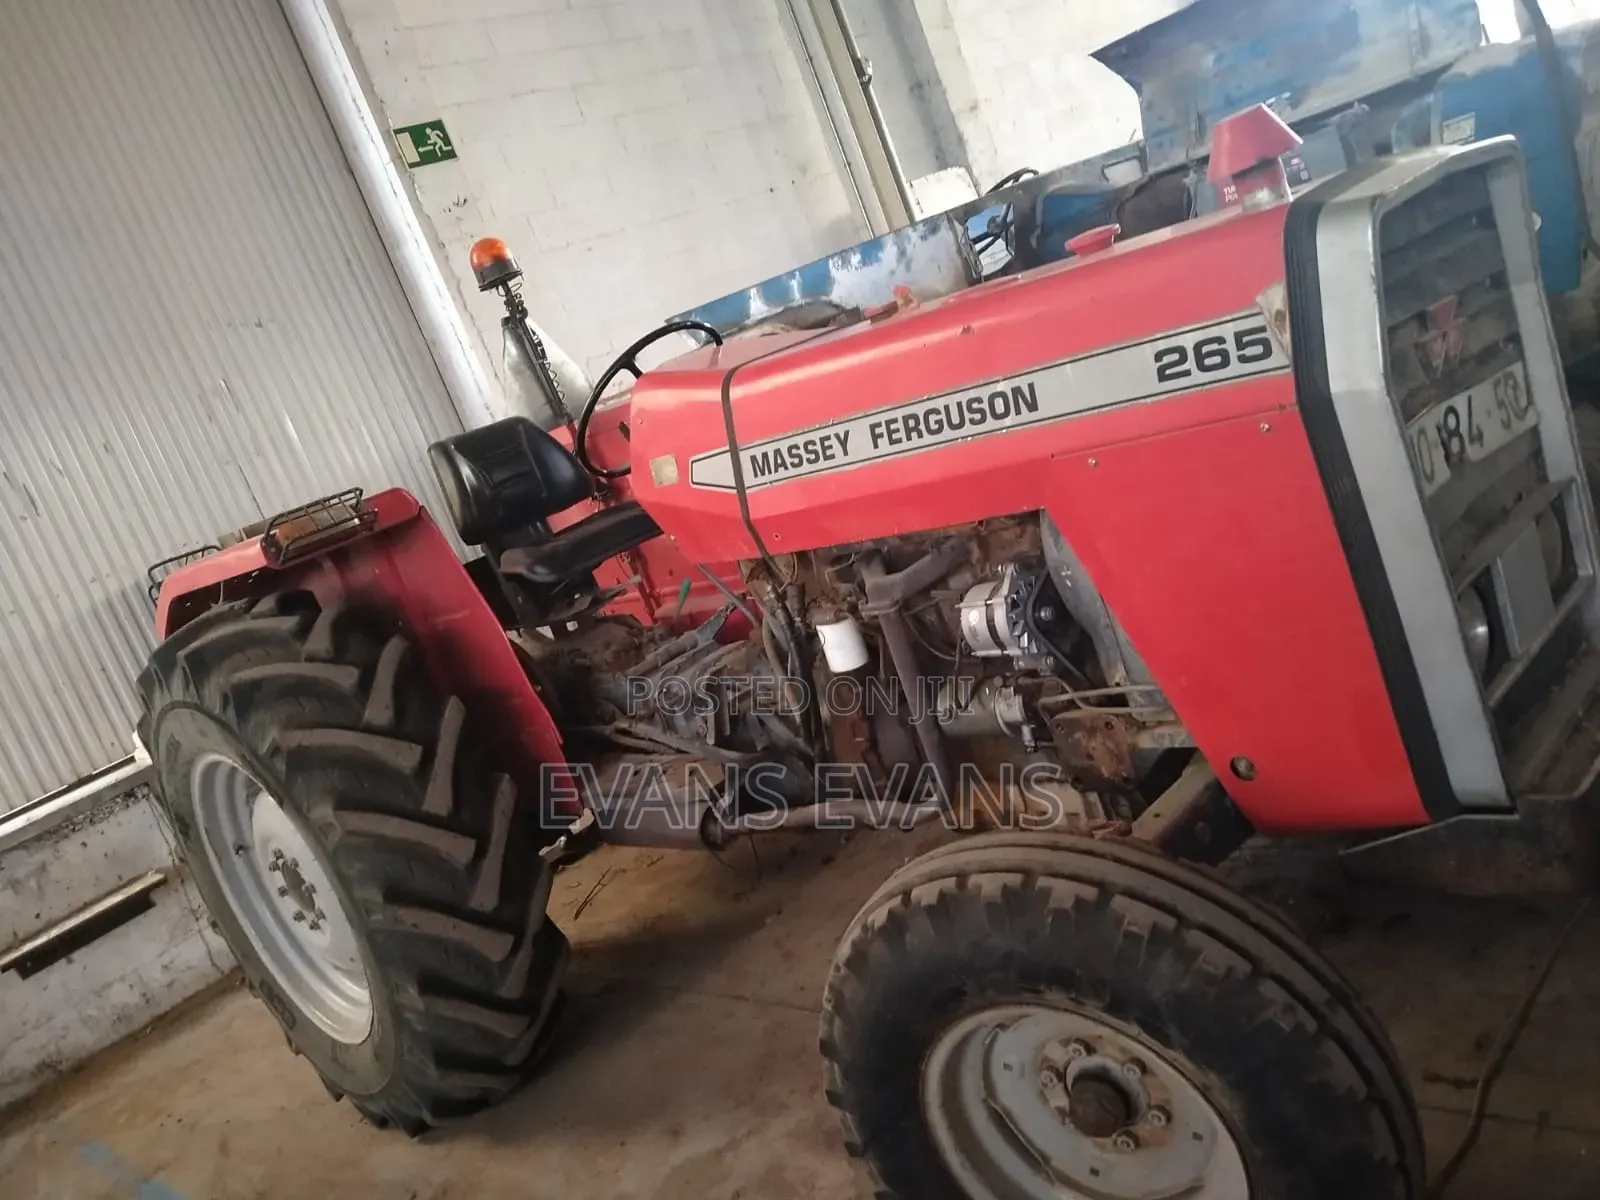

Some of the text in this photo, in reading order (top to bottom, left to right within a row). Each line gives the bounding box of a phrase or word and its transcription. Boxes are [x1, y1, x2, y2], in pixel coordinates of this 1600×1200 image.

[750, 325, 1272, 479] MASSEY FERGUSON 265
